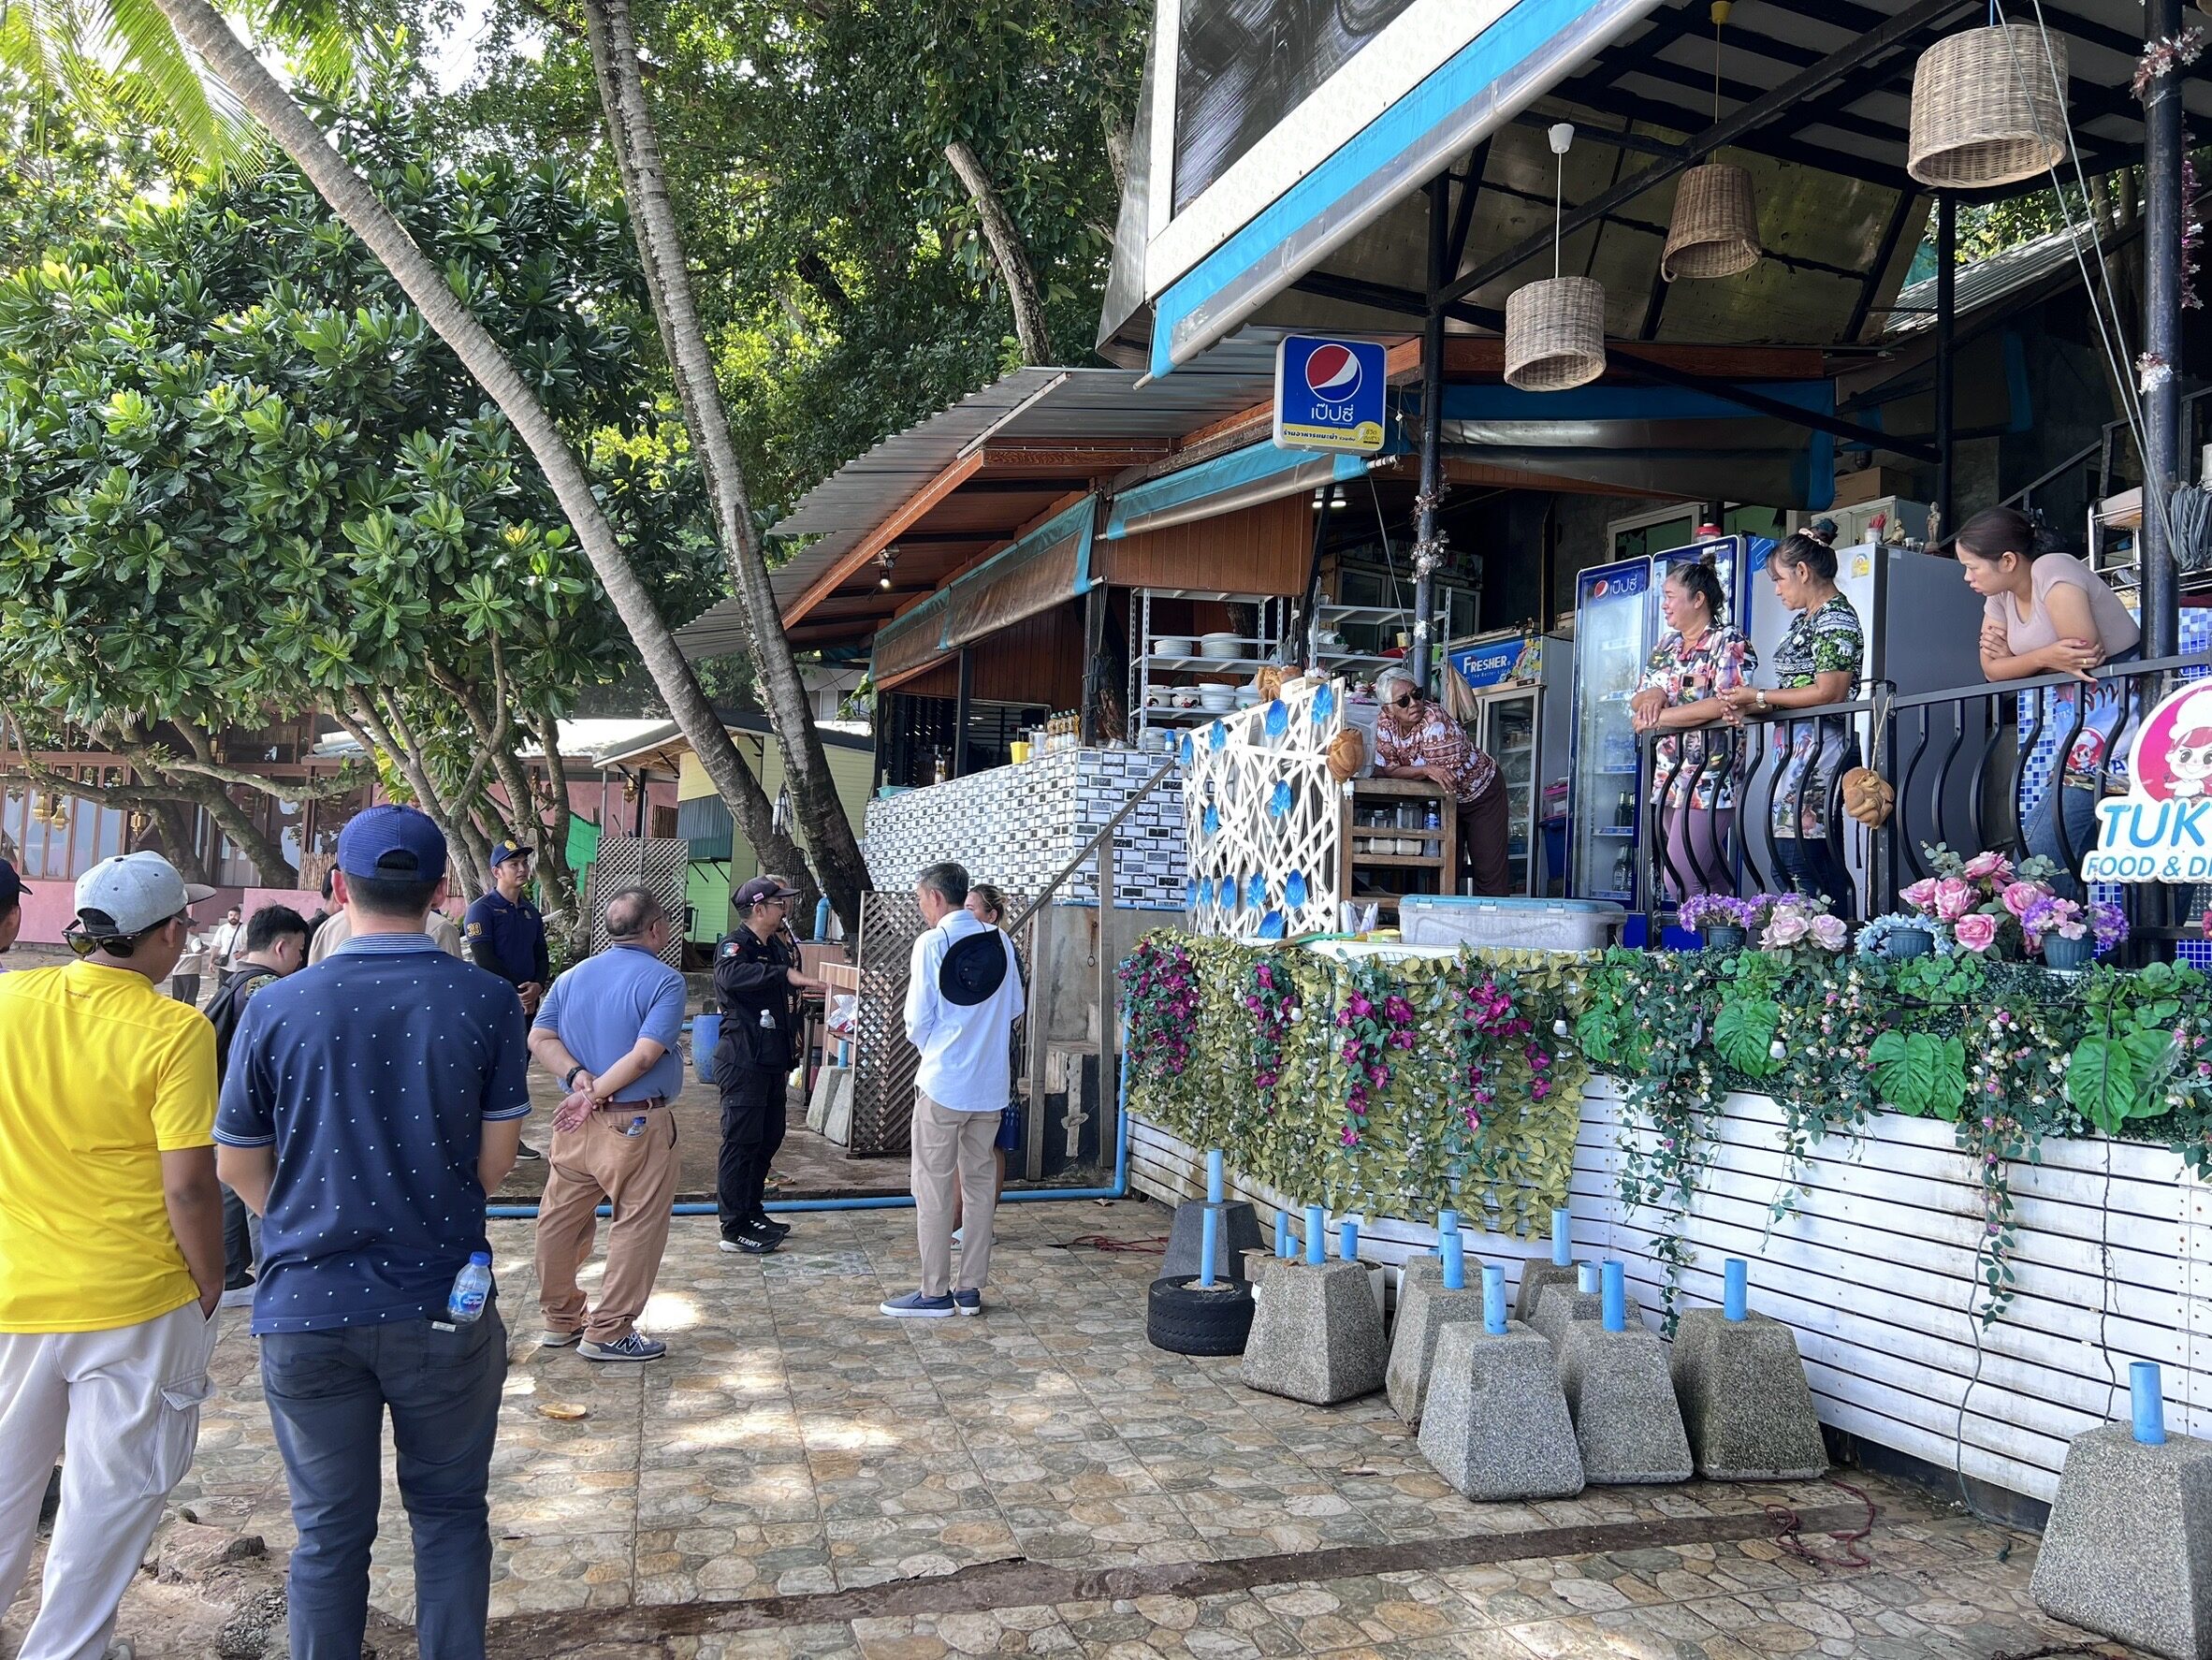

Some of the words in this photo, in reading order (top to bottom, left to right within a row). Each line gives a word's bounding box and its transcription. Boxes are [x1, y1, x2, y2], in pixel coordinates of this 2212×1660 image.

[1311, 403, 1354, 422] เป๊ปซี่
[1609, 575, 1637, 595] เป๊ปซี่
[1463, 655, 1507, 675] FRESHER
[2103, 801, 2212, 848] TUK
[2087, 855, 2156, 877] FOOD
[2162, 855, 2182, 877] &
